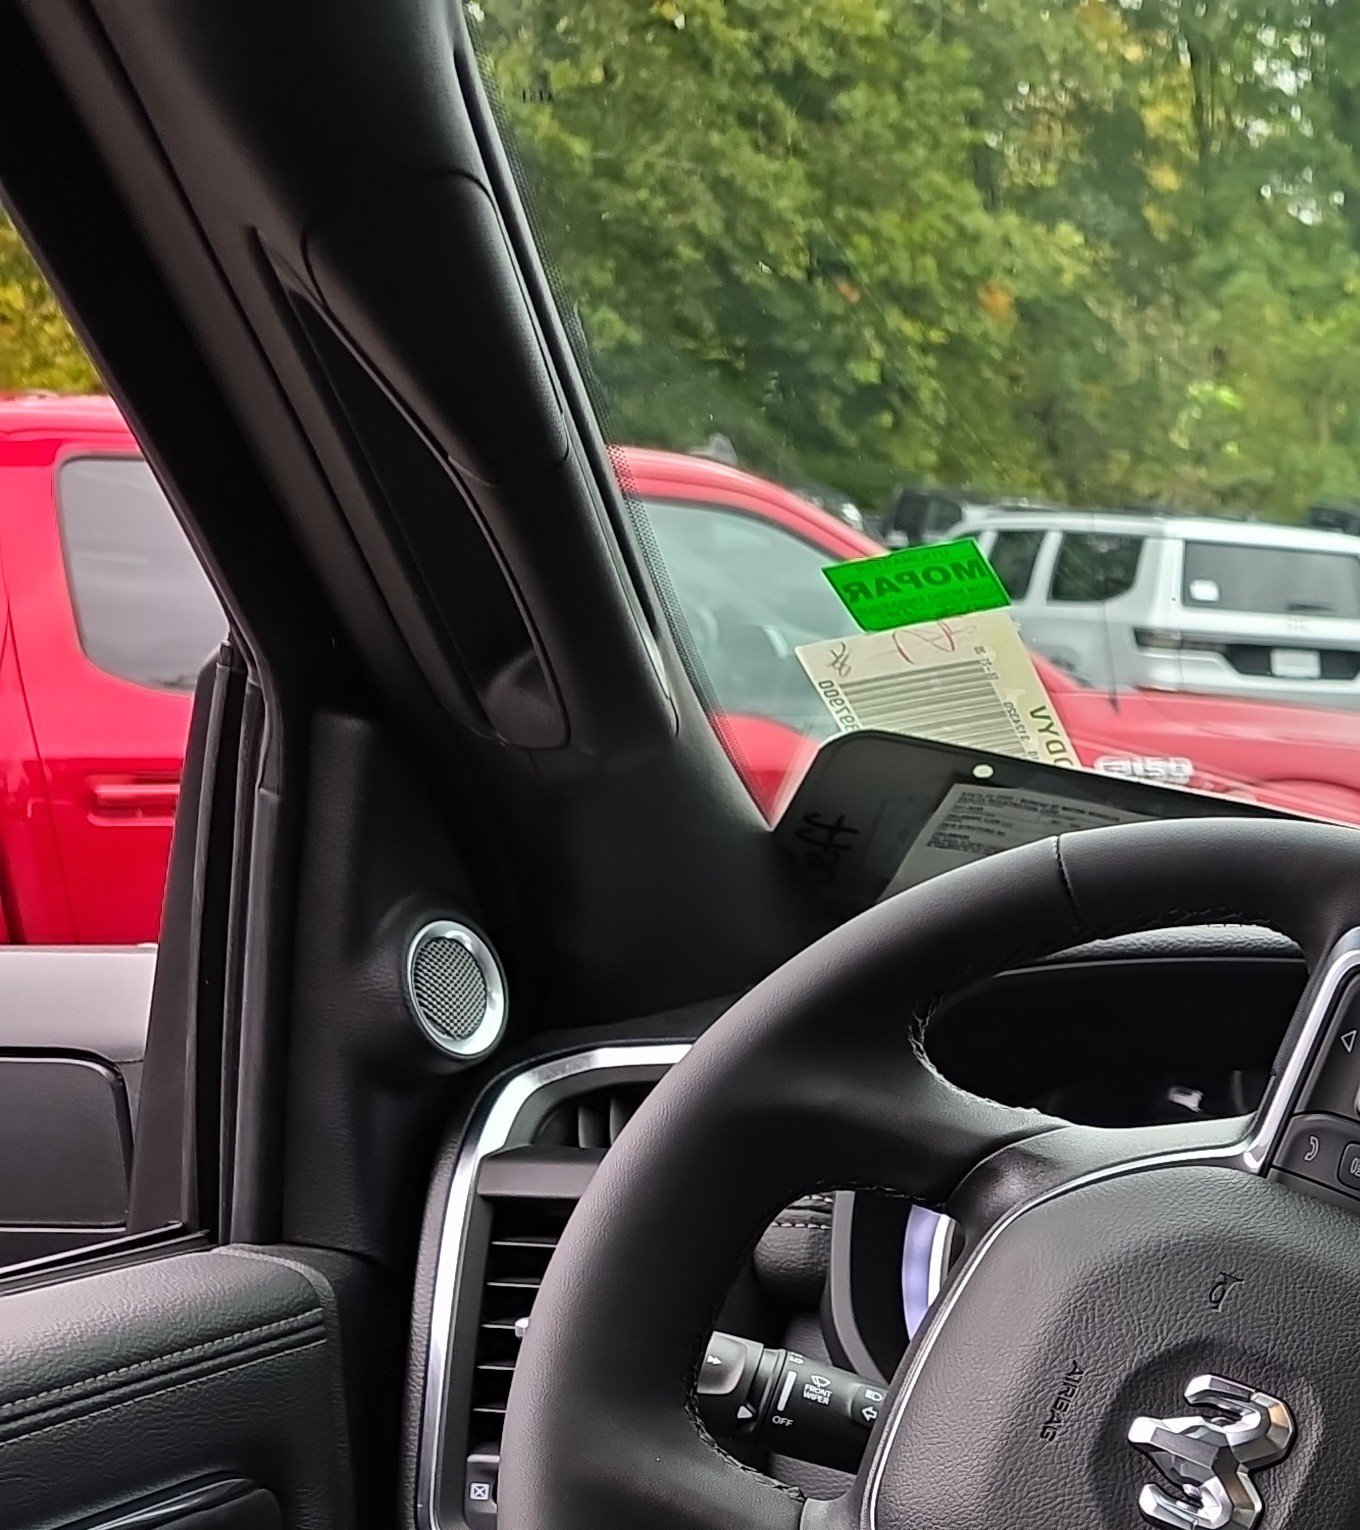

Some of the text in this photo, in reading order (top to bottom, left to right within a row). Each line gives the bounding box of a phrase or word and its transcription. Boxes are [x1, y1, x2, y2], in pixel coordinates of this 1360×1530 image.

[804, 1383, 833, 1398] FRONT
[802, 1391, 831, 1406] WIPER
[1039, 1359, 1084, 1442] AIRBAG
[771, 1415, 794, 1427] OFF
